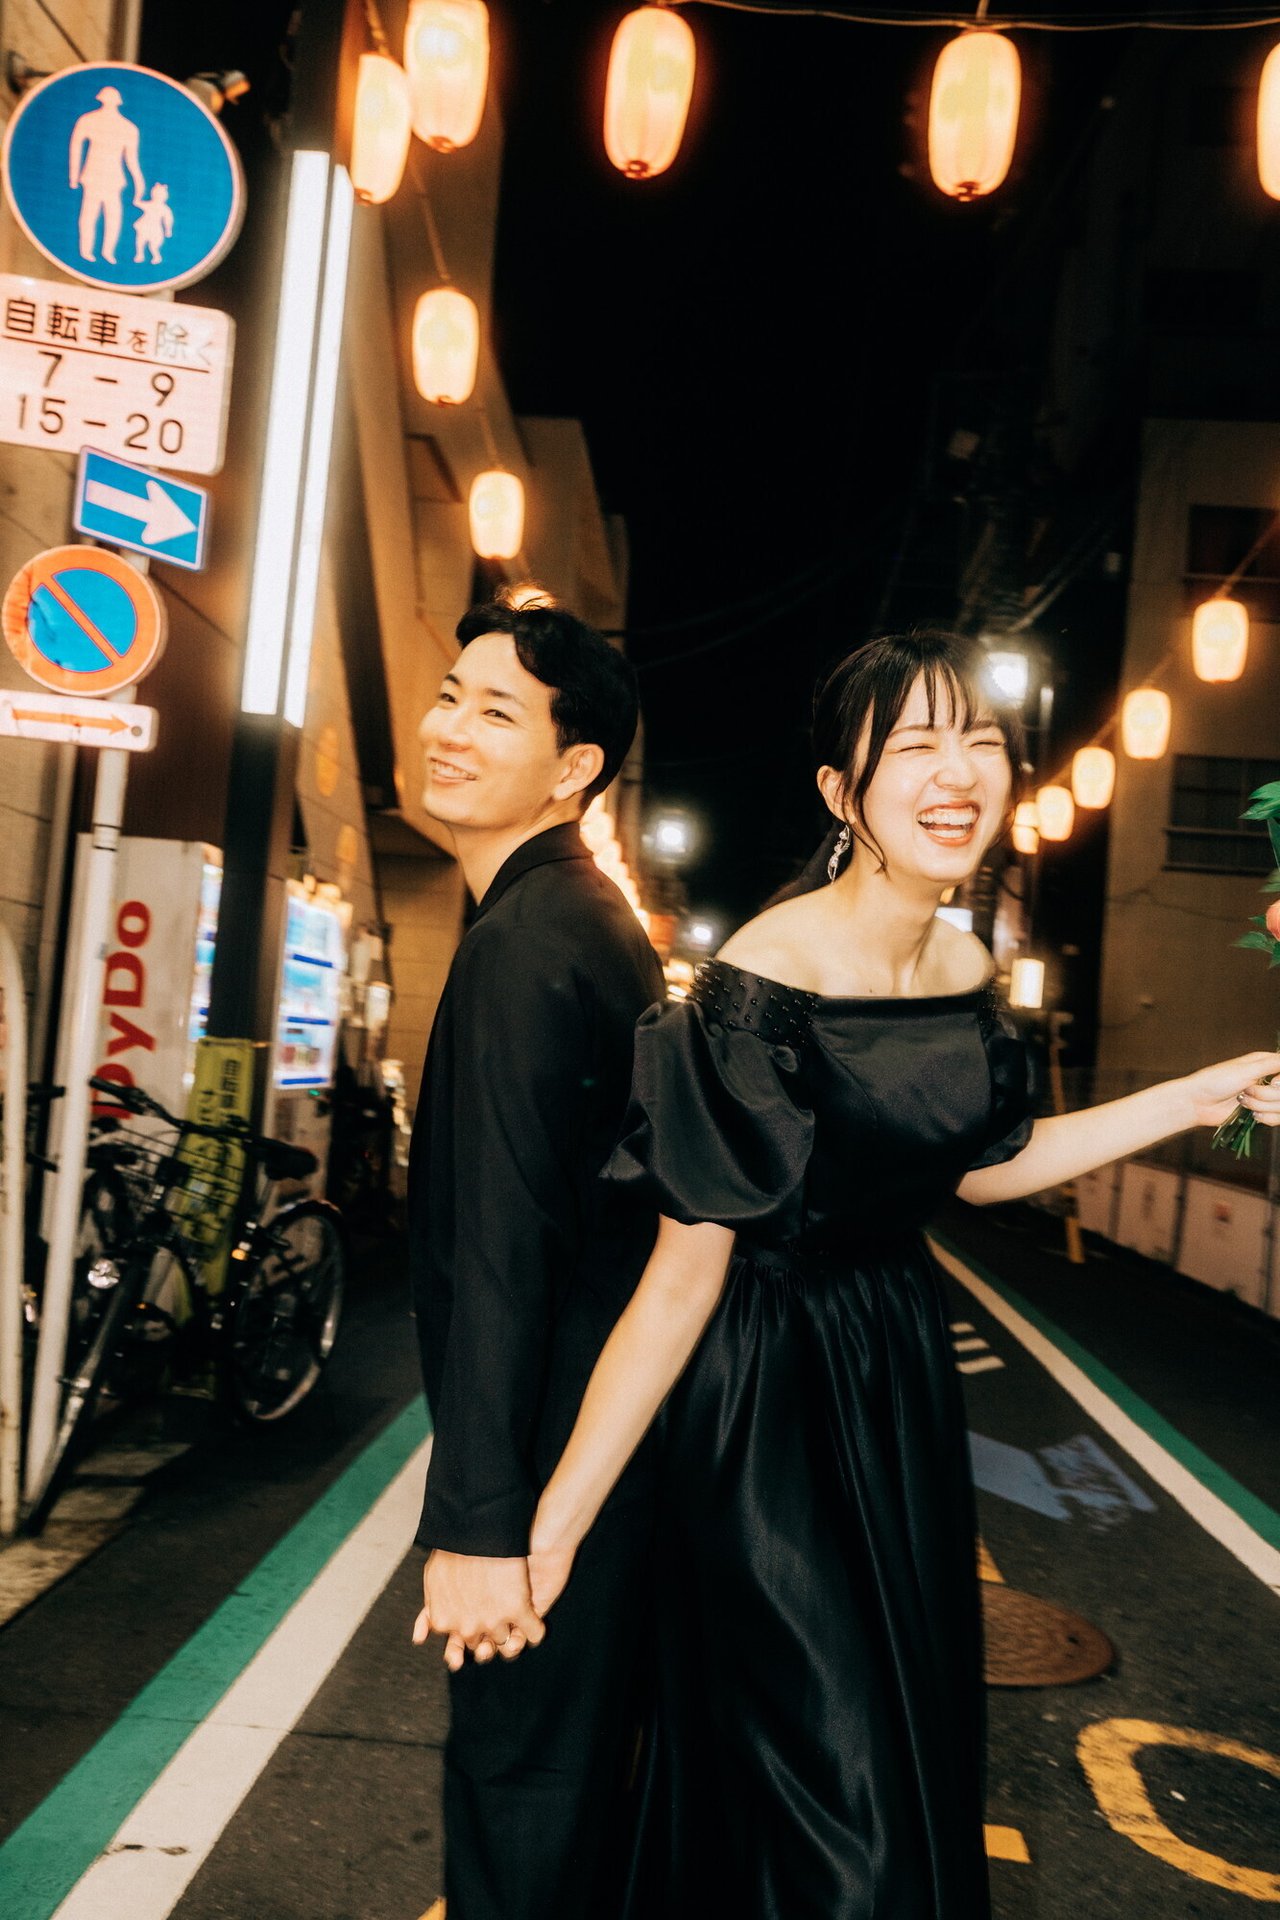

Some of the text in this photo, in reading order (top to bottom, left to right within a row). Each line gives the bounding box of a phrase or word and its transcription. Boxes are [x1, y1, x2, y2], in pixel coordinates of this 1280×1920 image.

[6, 297, 213, 366] 自転車を除く
[92, 901, 155, 1119] DyDo
